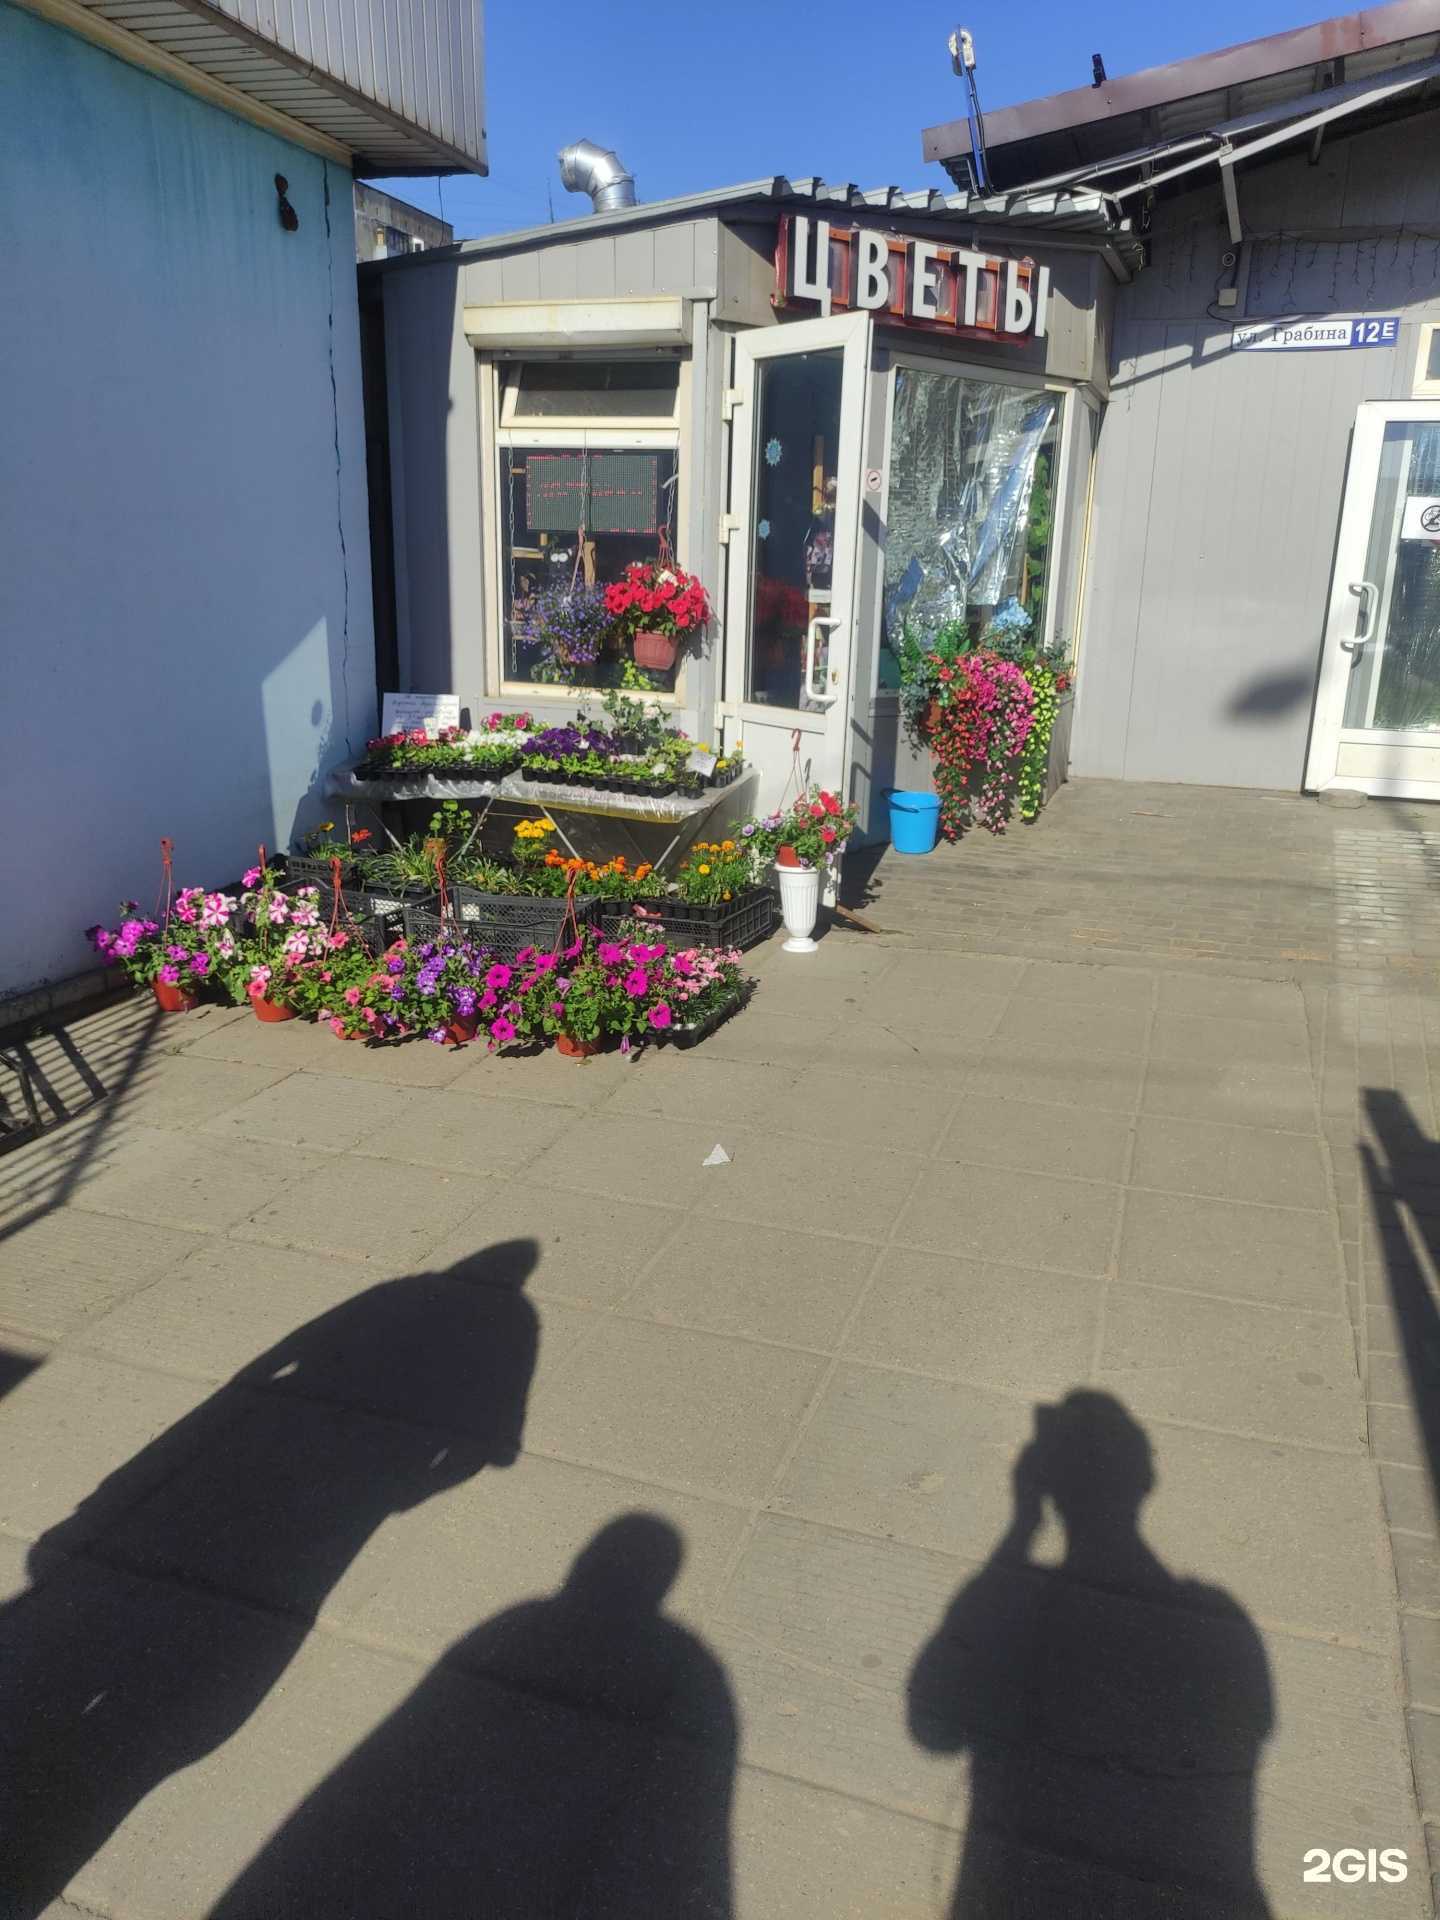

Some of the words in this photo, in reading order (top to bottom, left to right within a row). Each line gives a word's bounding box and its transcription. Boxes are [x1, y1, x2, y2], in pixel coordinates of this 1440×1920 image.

[793, 215, 1050, 337] ЦВЕТЫ
[1237, 332, 1263, 346] ул.
[1271, 325, 1347, 345] Грабина
